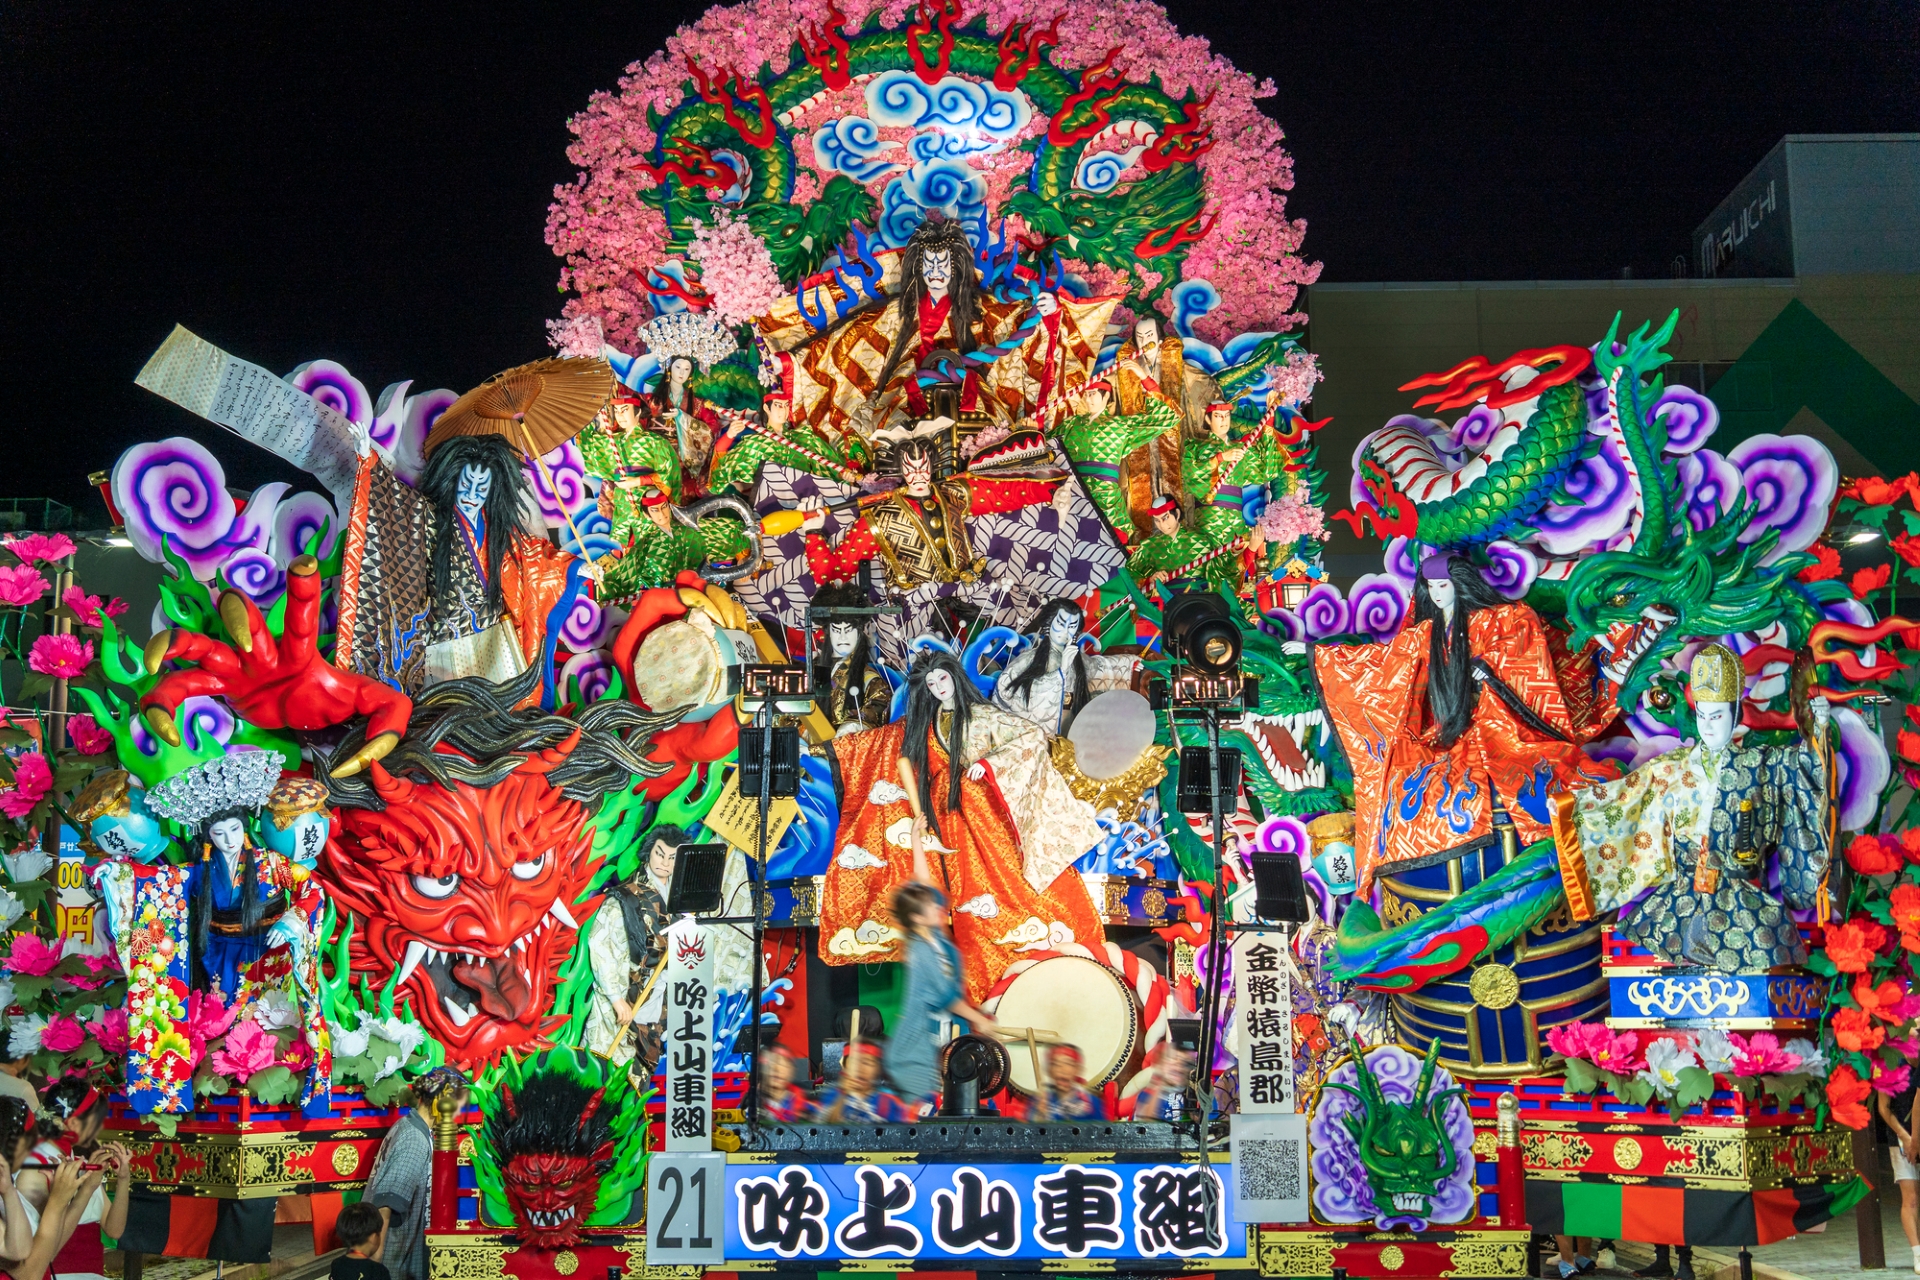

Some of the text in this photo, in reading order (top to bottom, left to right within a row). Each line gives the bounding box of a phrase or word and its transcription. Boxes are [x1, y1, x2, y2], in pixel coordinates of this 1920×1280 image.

[1701, 179, 1777, 279] MARUICHI
[671, 977, 707, 1139] 吹上山車組
[1245, 942, 1285, 1105] 金幣猿島郡
[656, 1166, 713, 1249] 21
[742, 1168, 1222, 1253] 吹上山車組
